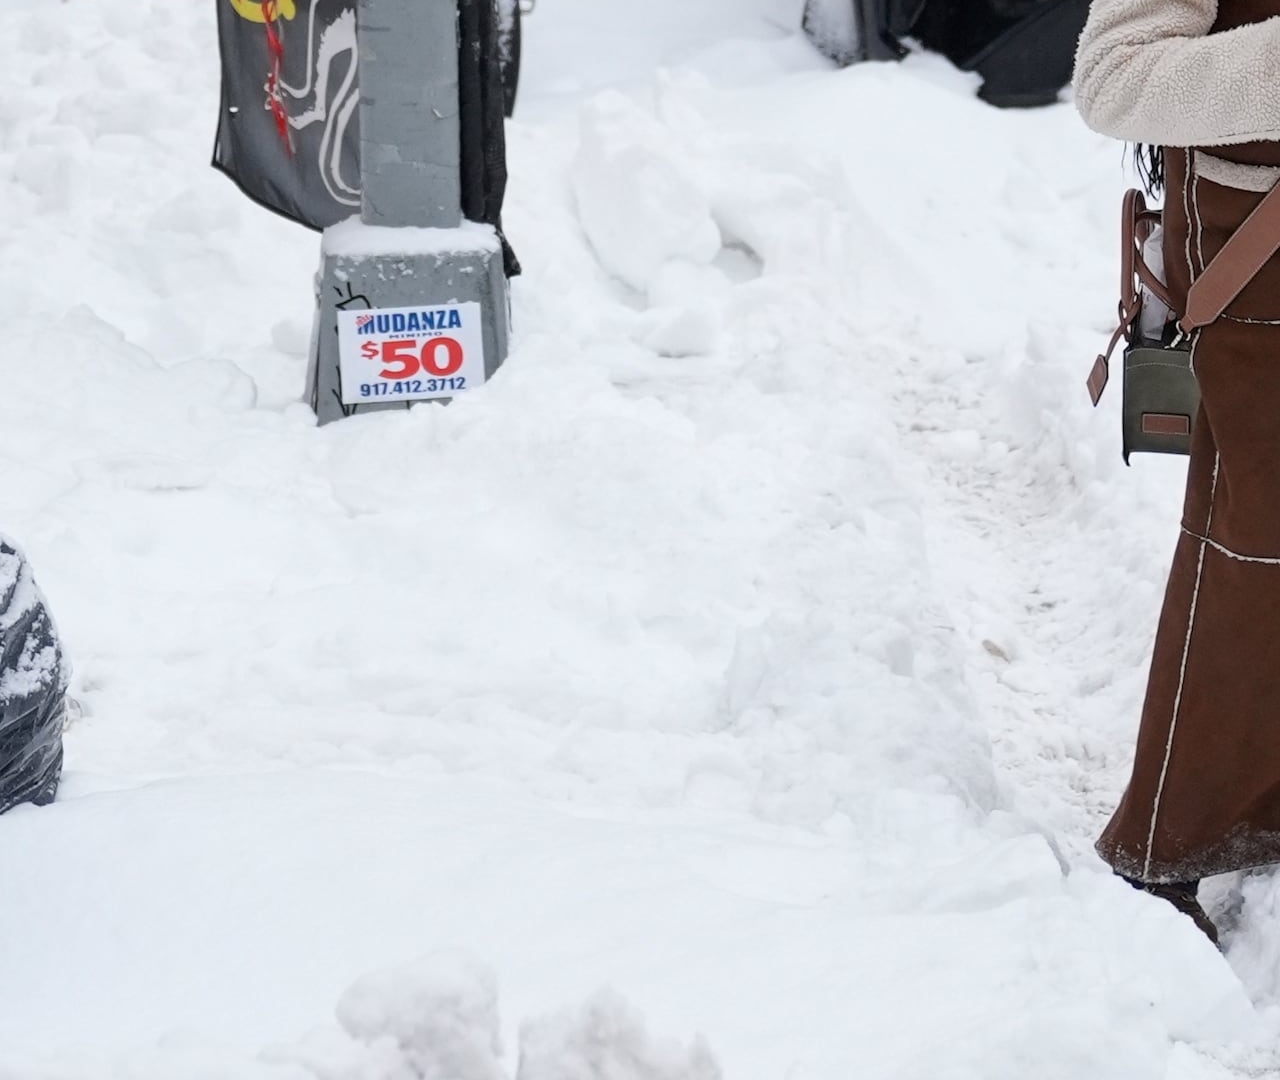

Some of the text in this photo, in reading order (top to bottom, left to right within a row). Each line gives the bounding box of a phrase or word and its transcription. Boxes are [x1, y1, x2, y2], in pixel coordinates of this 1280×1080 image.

[356, 309, 462, 335] MUDANZA
[360, 336, 464, 380] $50
[360, 377, 466, 397] 917.412.3712
